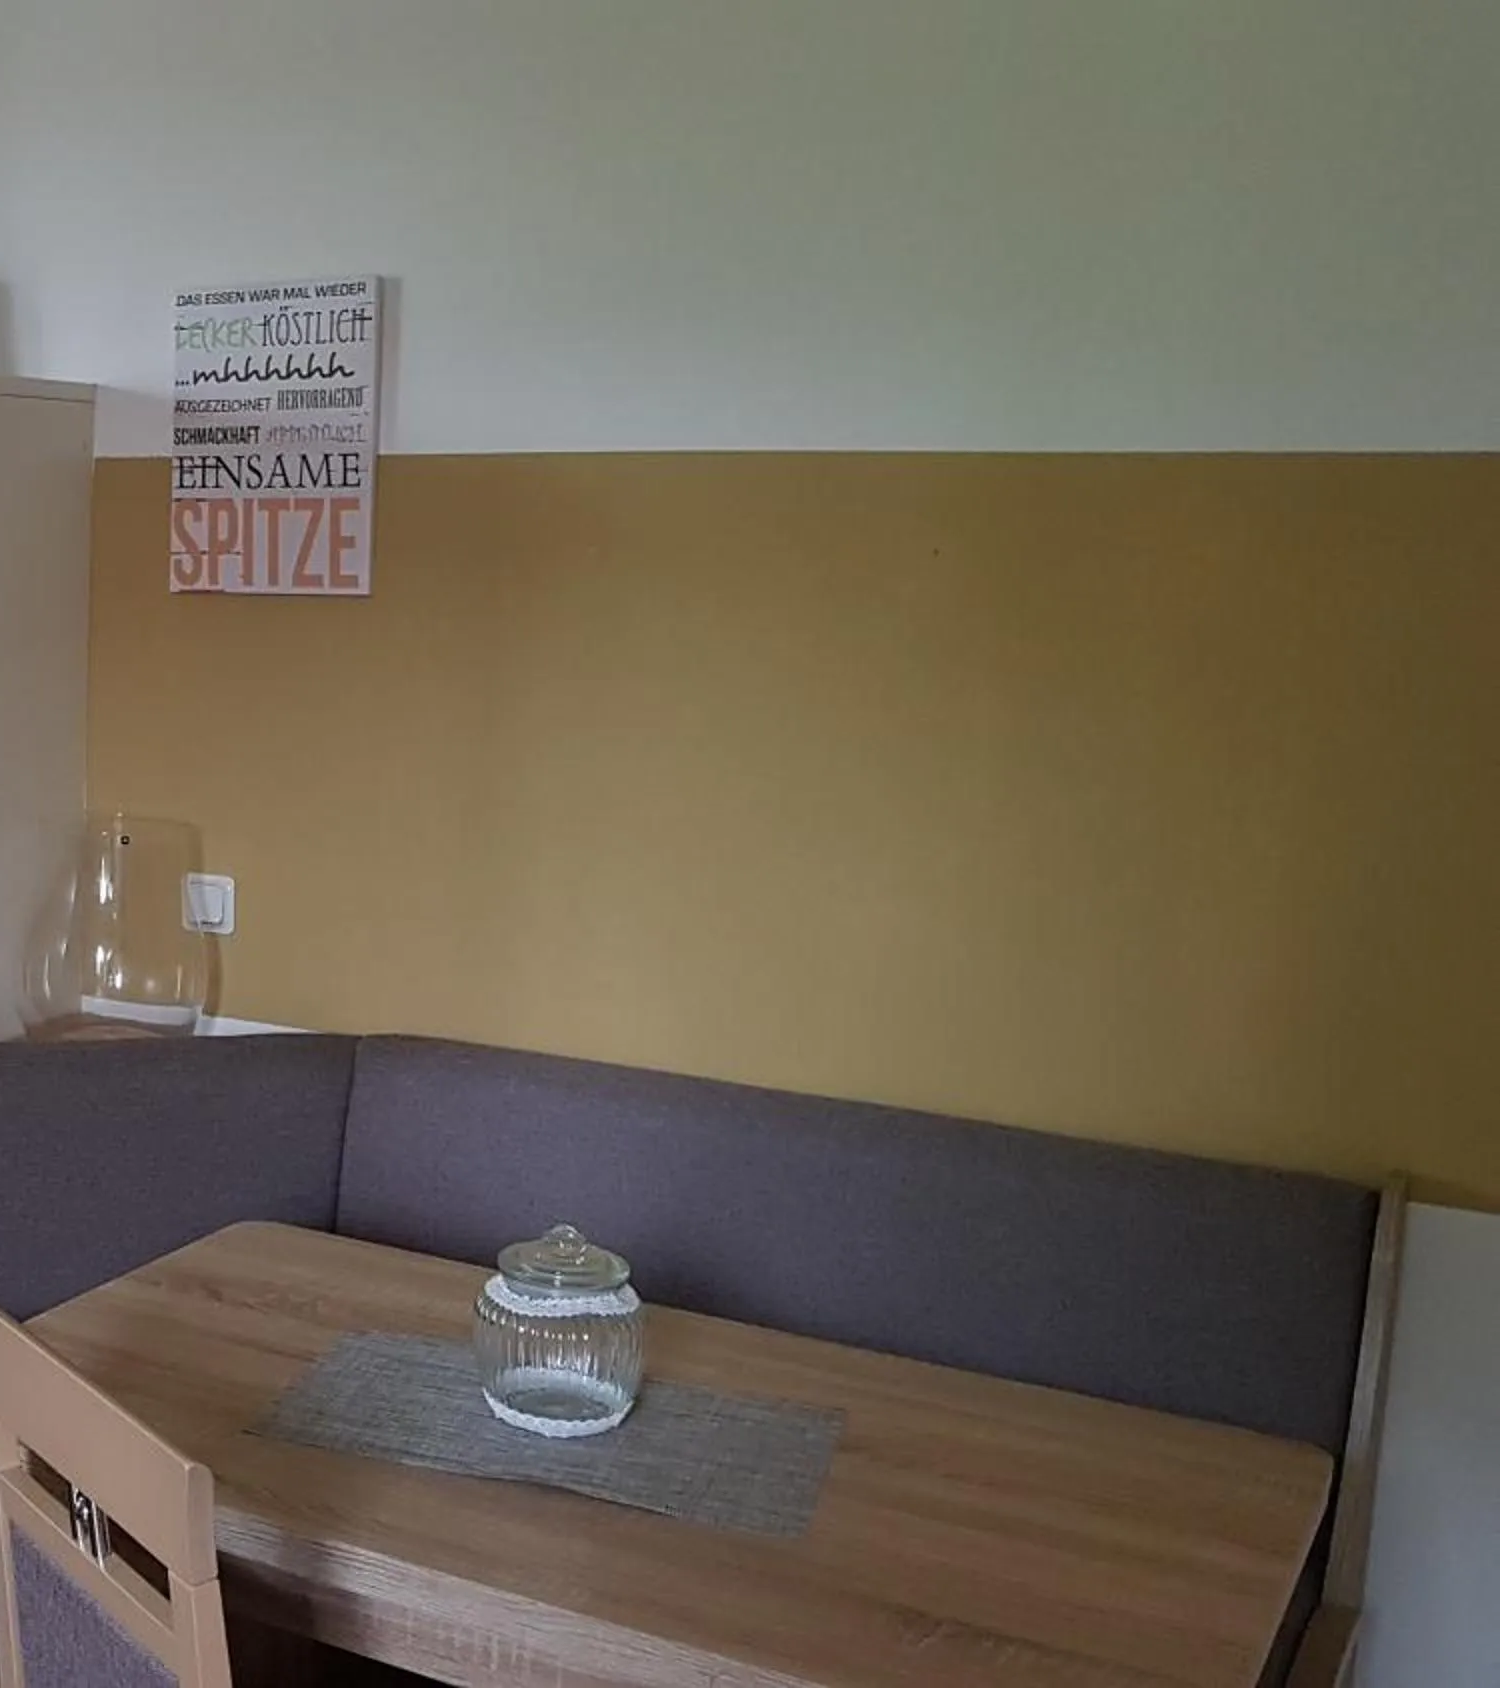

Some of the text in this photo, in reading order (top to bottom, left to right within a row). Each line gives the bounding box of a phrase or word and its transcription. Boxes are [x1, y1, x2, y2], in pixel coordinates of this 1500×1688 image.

[175, 281, 367, 307] DAS ESSEN WAR MAL WIEDER
[174, 305, 368, 353] LECKER KÖSTLICH
[174, 387, 364, 415] AUSGEZEICHNET HERVORRAGEND
[173, 425, 261, 446] SCHMACKHAFT
[174, 452, 362, 490] EINSAME
[173, 497, 361, 589] SPITZE
